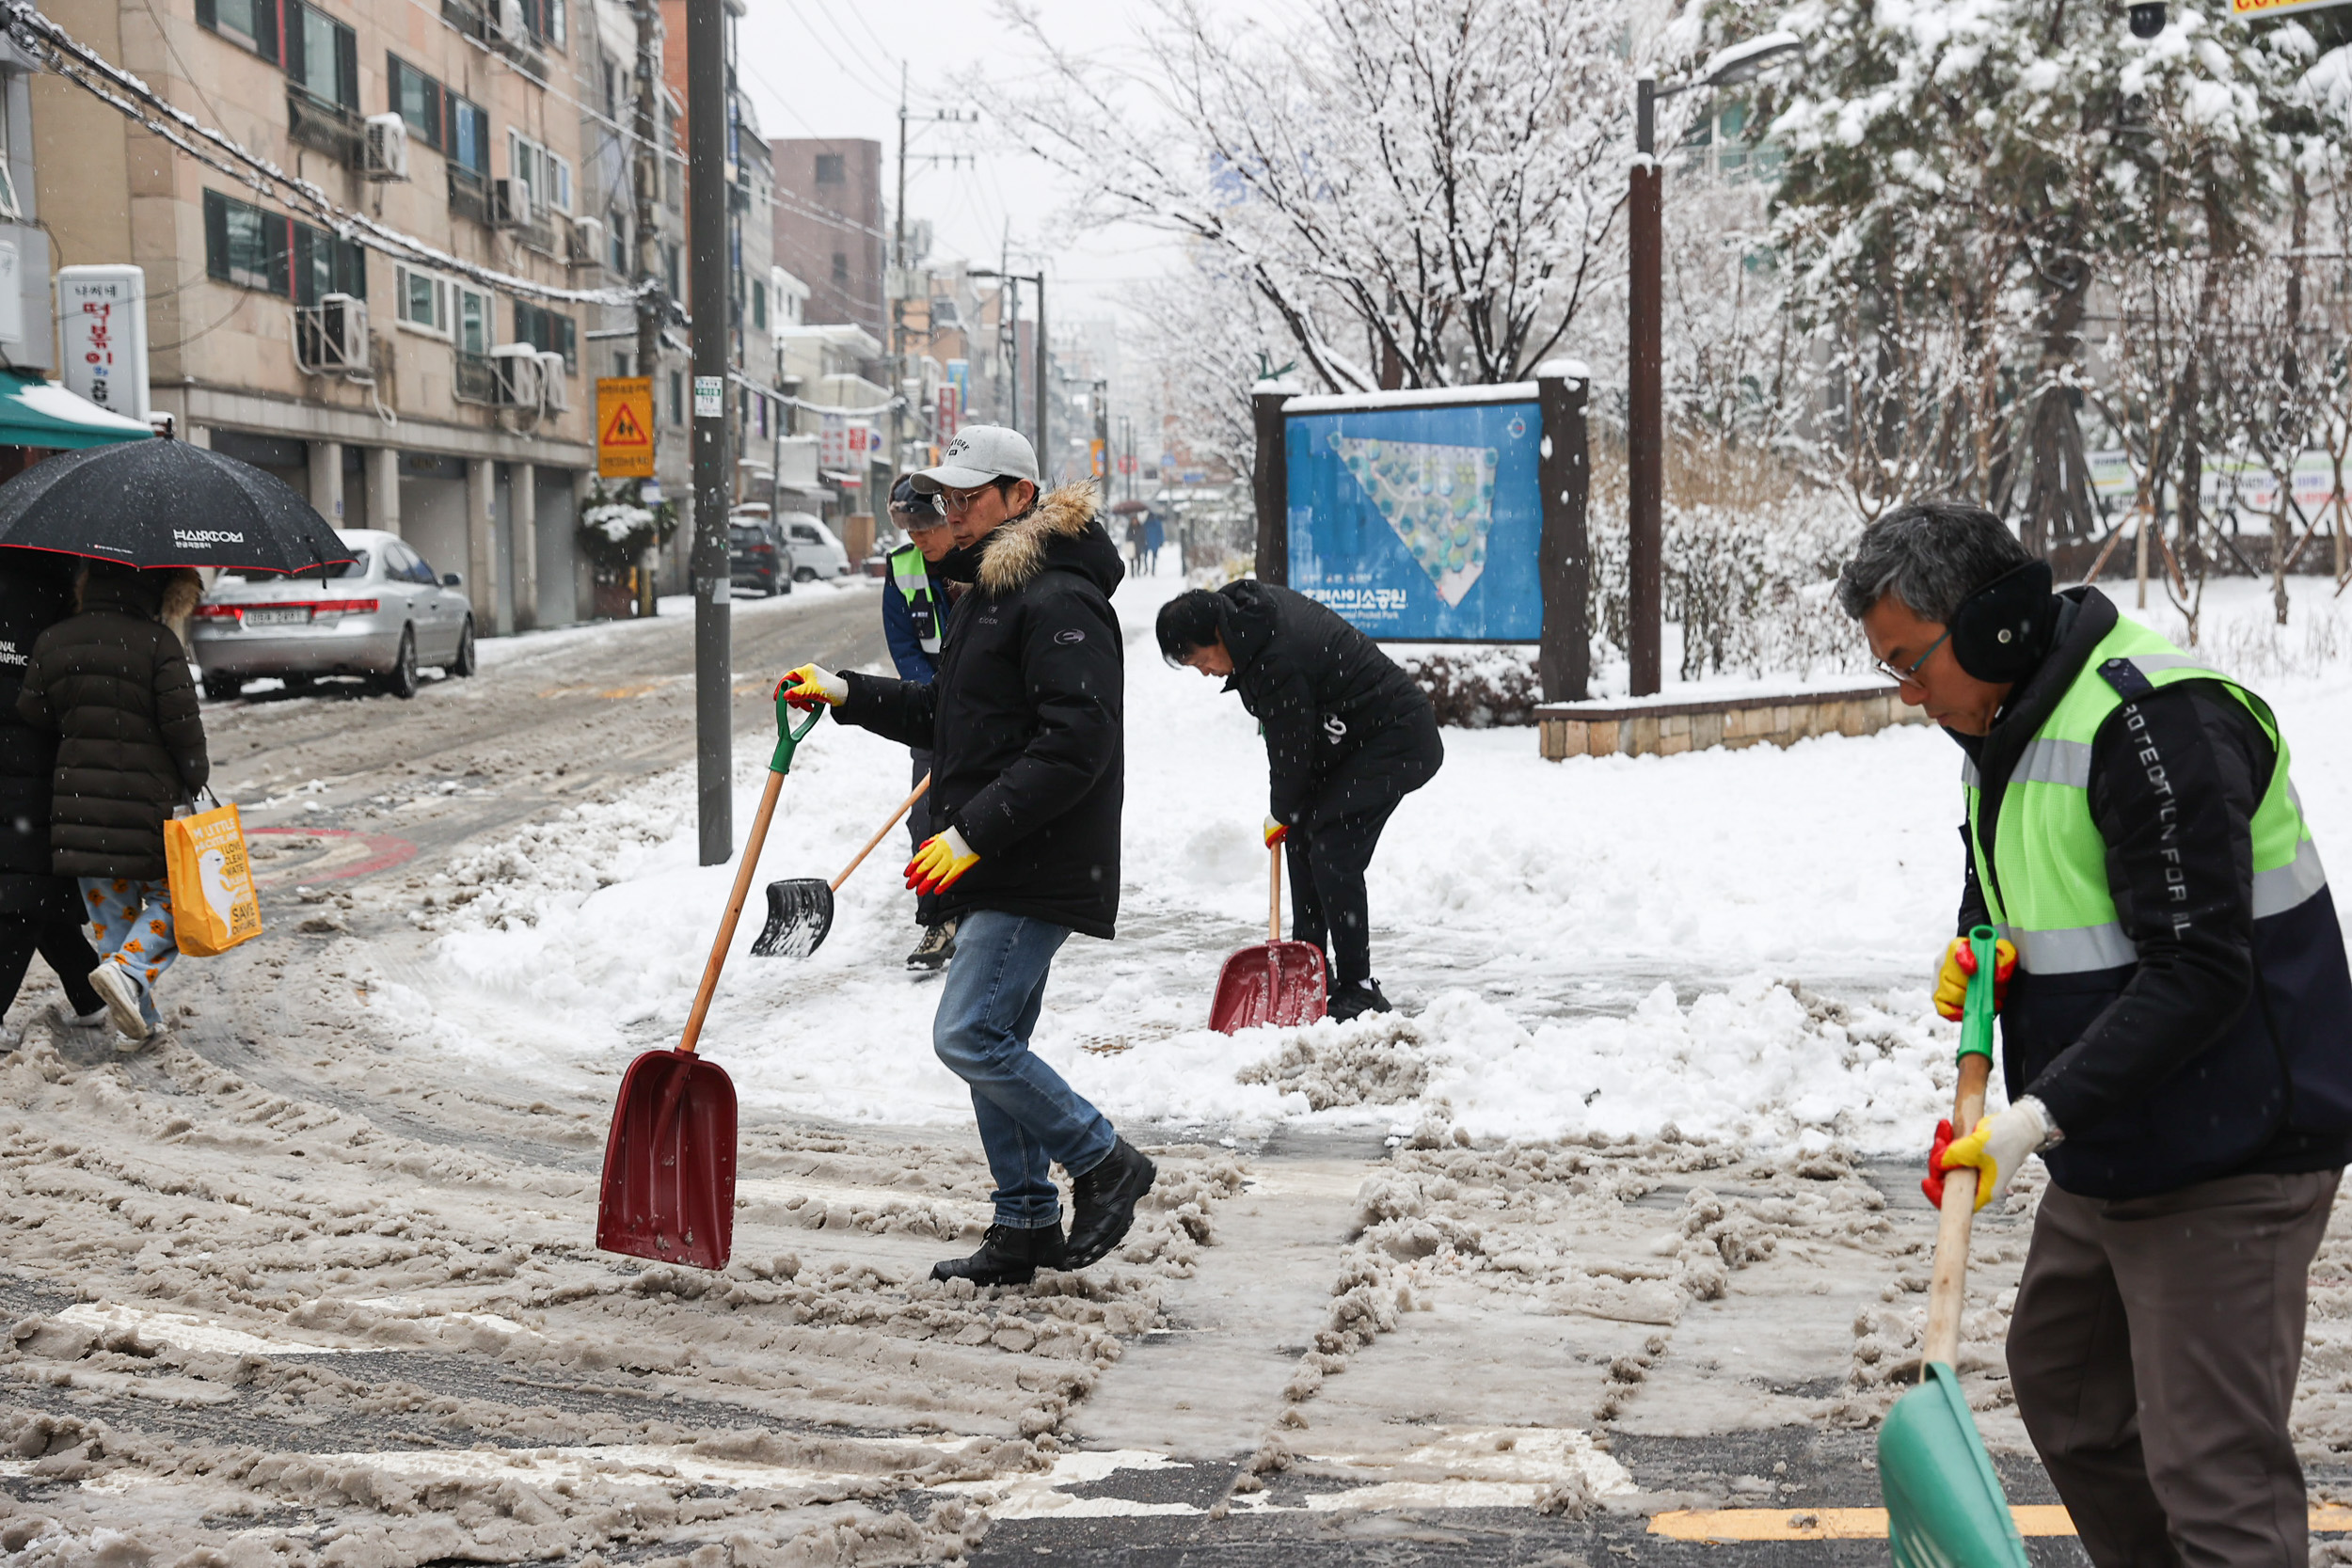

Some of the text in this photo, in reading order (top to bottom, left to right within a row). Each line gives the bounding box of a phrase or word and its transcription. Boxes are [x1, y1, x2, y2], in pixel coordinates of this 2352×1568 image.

[83, 301, 114, 366] 떡볶이
[173, 529, 245, 543] HANCOM
[204, 817, 236, 837] LITTLE
[2160, 847, 2187, 902] FOR
[231, 902, 256, 923] SAVE
